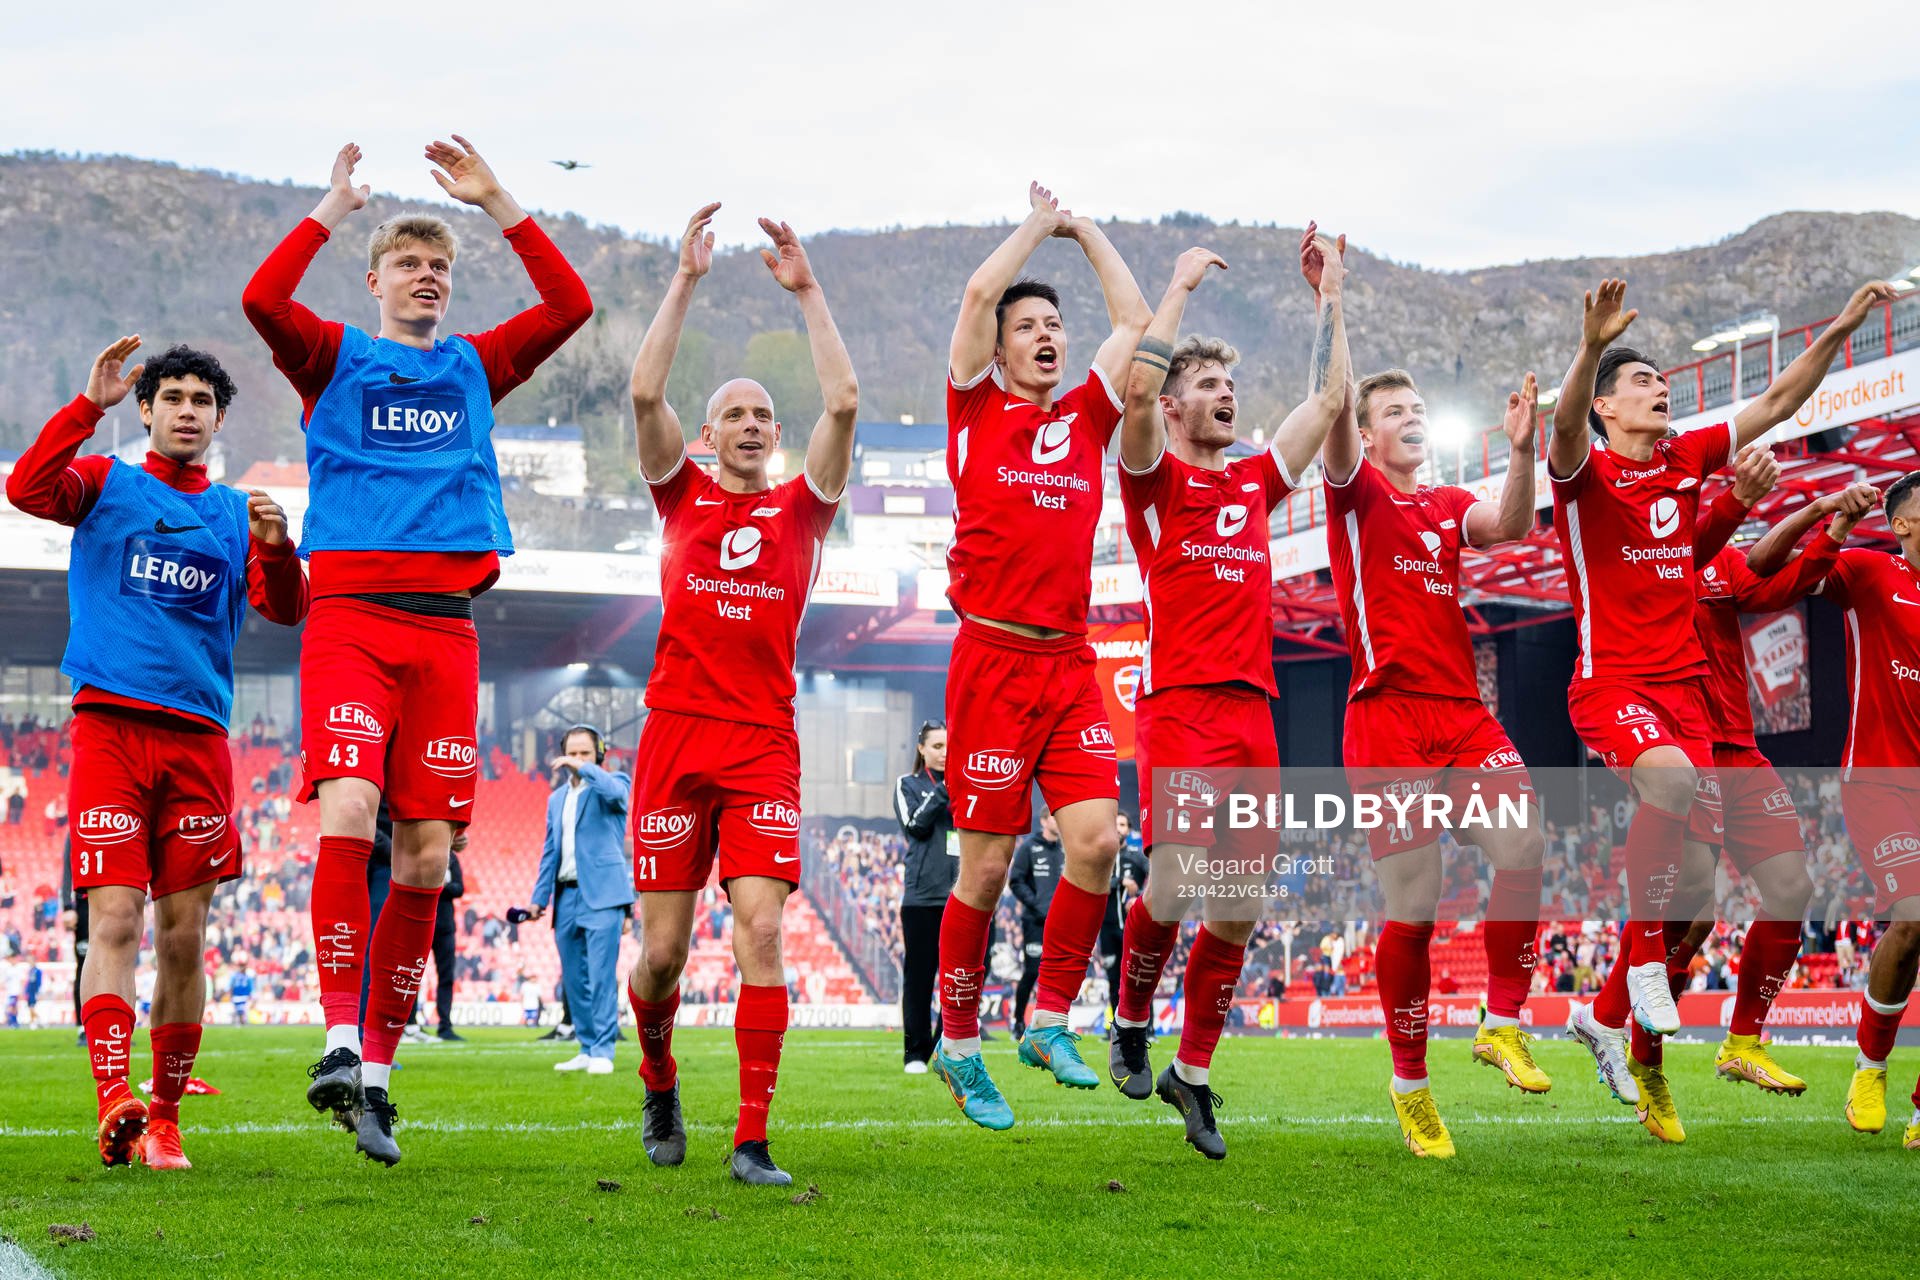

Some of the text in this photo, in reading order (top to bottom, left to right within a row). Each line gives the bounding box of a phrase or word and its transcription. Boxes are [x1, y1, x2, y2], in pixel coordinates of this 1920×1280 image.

[1818, 370, 1905, 420] Fjordkraft
[372, 405, 458, 434] LERØY
[997, 465, 1090, 493] Sparebanken
[1032, 489, 1067, 510] Vest
[1181, 540, 1266, 564] Sparebanken
[130, 554, 216, 593] LERØY
[1214, 563, 1245, 583] Vest
[1655, 564, 1684, 580] Vest
[686, 573, 785, 601] Sparebanken
[1423, 577, 1453, 597] Vest
[716, 599, 752, 621] Vest
[330, 706, 384, 735] LERØY
[1617, 703, 1656, 720] LER
[1631, 724, 1660, 744] 13
[328, 743, 359, 768] 43
[968, 753, 1021, 775] LERØY
[1480, 751, 1522, 773] LERØ
[1169, 771, 1218, 797] LERØY
[1383, 778, 1431, 801] LERØY
[966, 795, 978, 819] 7
[79, 811, 140, 831] LERØY
[640, 814, 693, 834] LERØY
[1387, 819, 1414, 844] 20
[79, 850, 104, 876] 31
[639, 855, 657, 880] 21
[1885, 872, 1899, 893] 6
